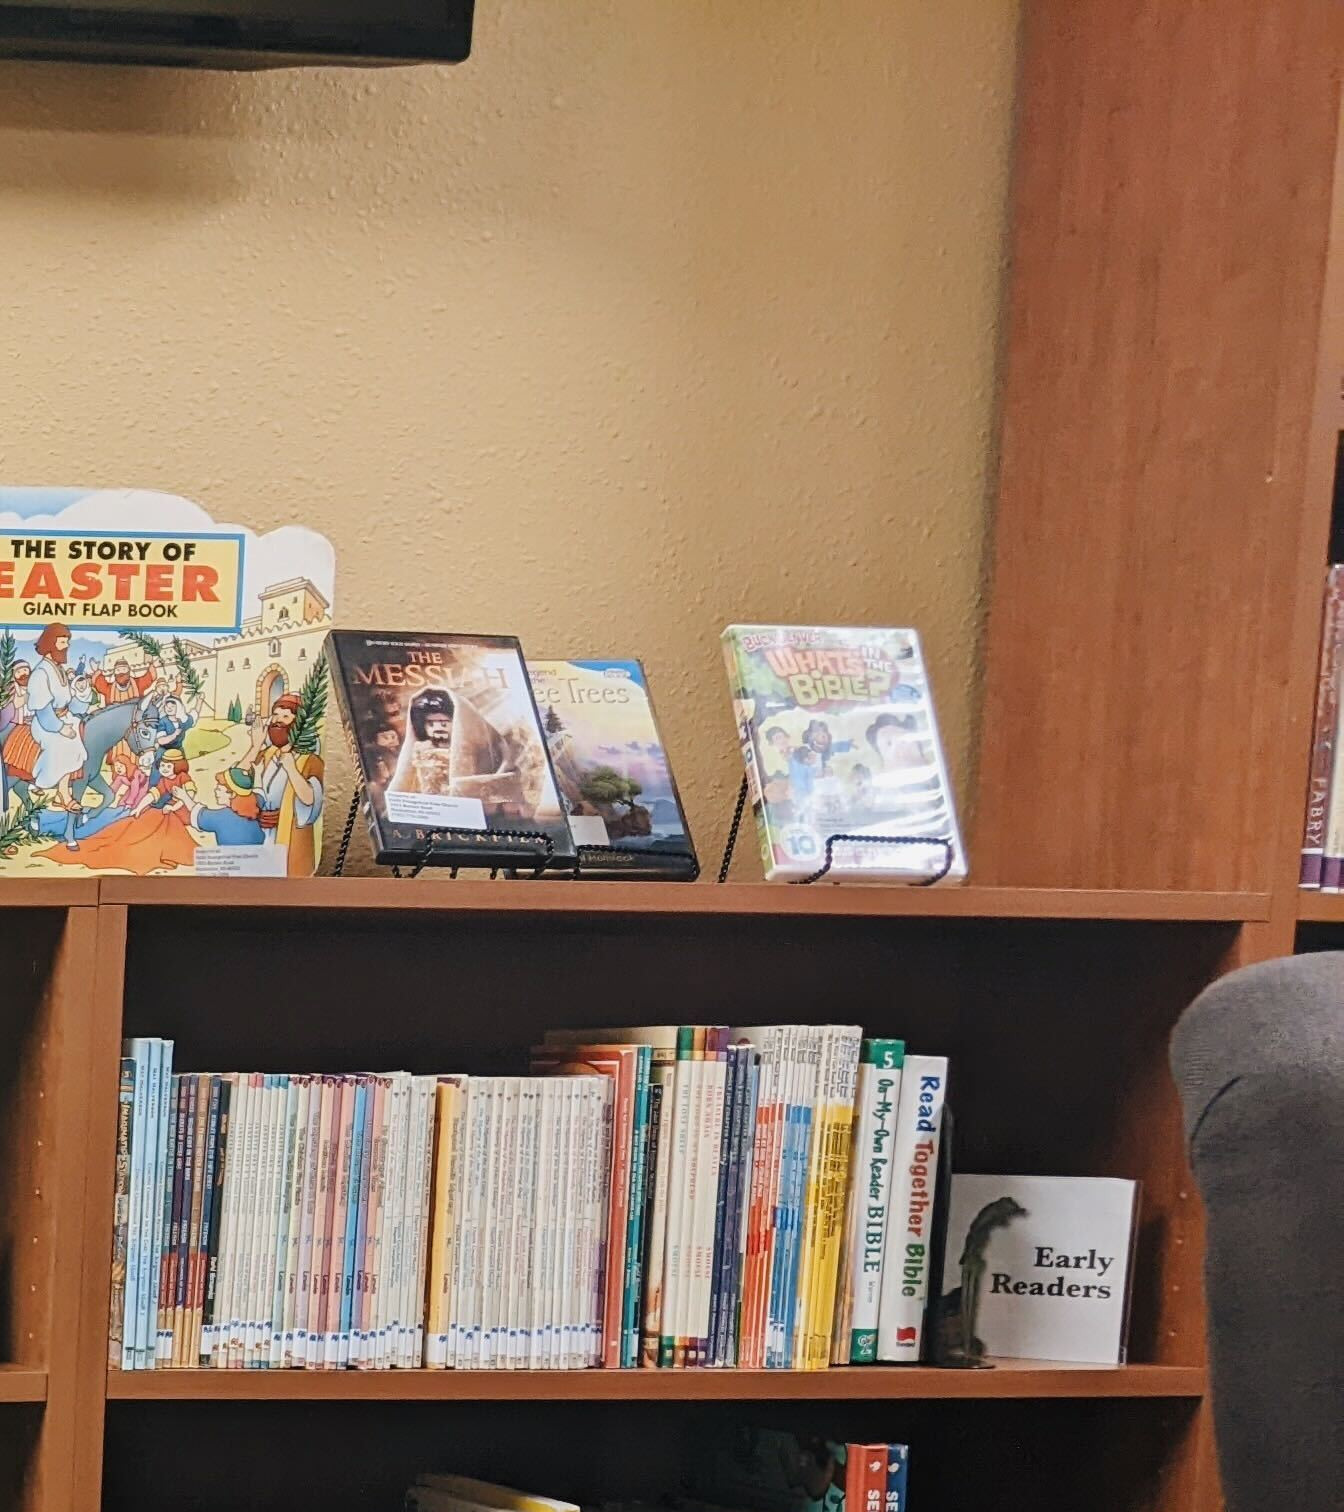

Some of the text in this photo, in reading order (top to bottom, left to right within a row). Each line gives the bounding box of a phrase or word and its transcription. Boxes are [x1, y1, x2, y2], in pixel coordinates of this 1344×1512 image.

[10, 539, 196, 562] THE STORY OF
[23, 602, 178, 619] GIANT FLAP BOOK
[407, 651, 442, 665] THE
[559, 677, 631, 704] Trees
[882, 1051, 894, 1069] 5
[901, 1075, 941, 1298] Read Together Bible
[862, 1206, 886, 1274] BIBLE
[1033, 1246, 1114, 1274] Early
[990, 1273, 1112, 1301] Readers
